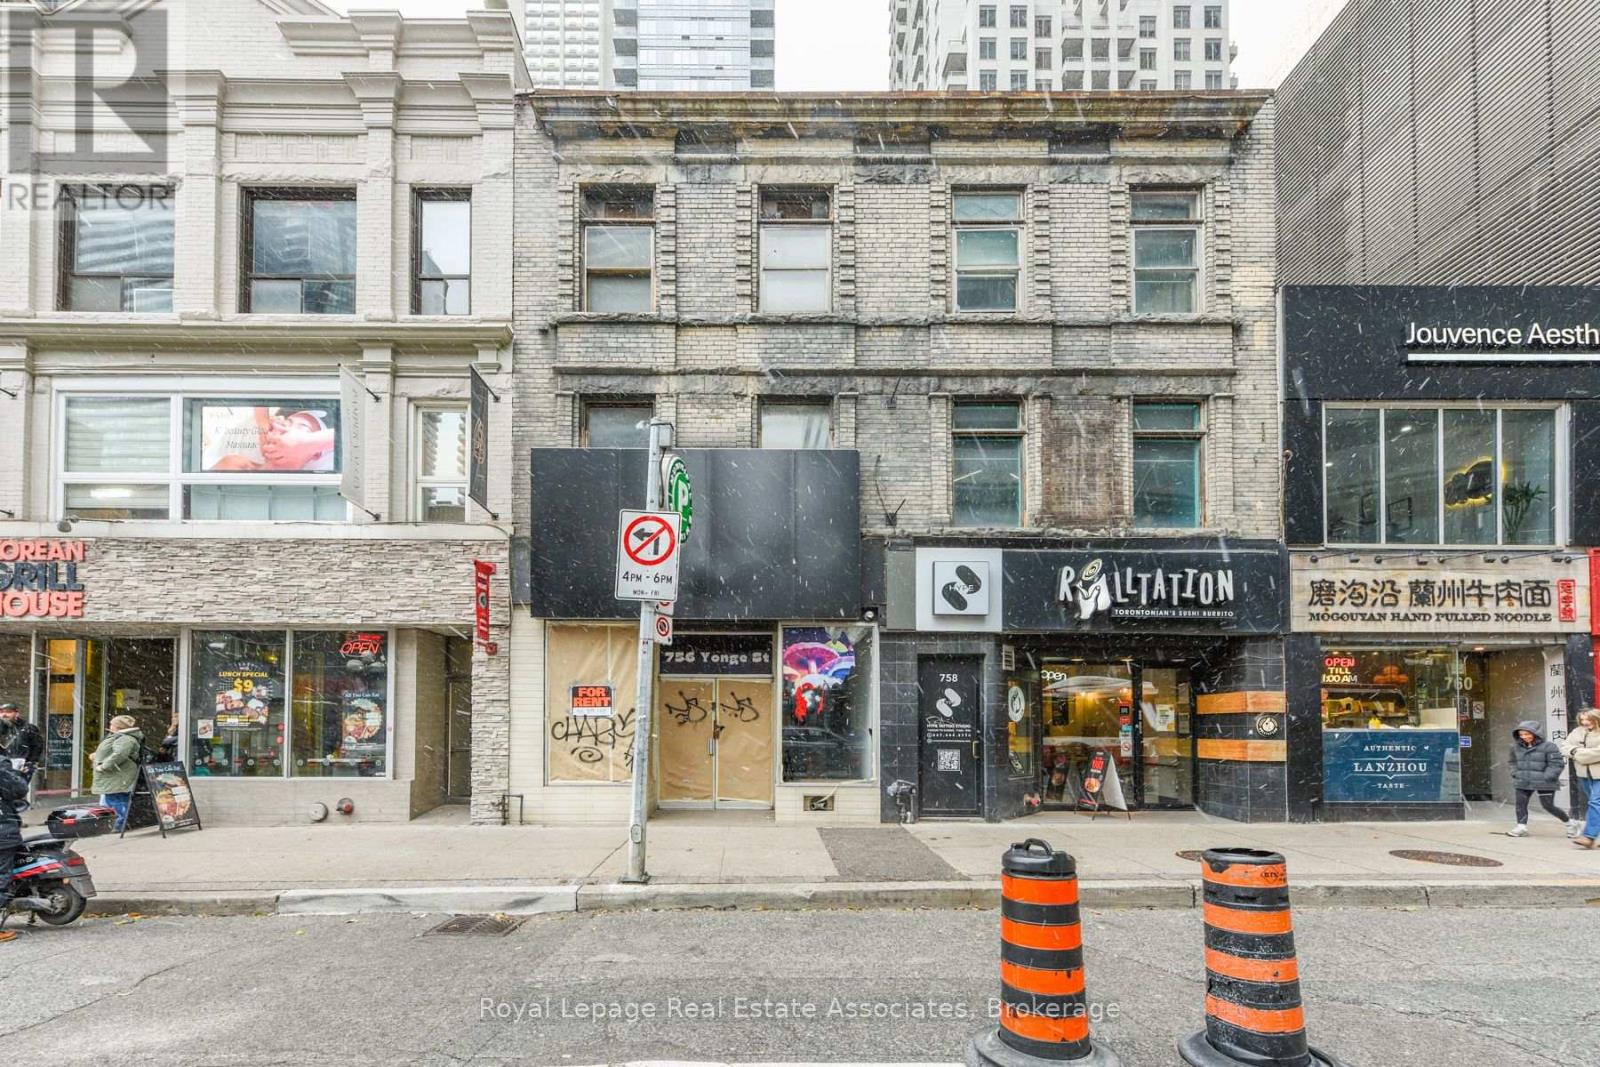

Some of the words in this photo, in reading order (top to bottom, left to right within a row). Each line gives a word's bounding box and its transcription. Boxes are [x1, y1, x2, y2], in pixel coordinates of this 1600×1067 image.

[1406, 322, 1522, 345] Jouvence
[1527, 322, 1600, 345] Aesth
[0, 538, 86, 562] OREAN
[622, 570, 642, 584] 4PM
[653, 572, 673, 584] 6PM
[948, 584, 974, 592] HYPE
[0, 591, 84, 617] OUSE
[1114, 608, 1176, 617] TORONTONIAN'S
[1202, 610, 1235, 618] BURRITO
[1308, 612, 1387, 622] MOGOUYAN
[1390, 612, 1432, 622] HAND
[1434, 612, 1491, 622] PULLED
[1494, 612, 1553, 623] NOODLE
[339, 640, 380, 655] OPEN
[664, 652, 696, 662] 756
[700, 652, 748, 665] Yonge
[751, 652, 770, 663] St
[1325, 657, 1356, 667] OPEN
[1327, 667, 1352, 675] TILL
[939, 673, 959, 683] 758
[1341, 675, 1358, 683] AM
[1443, 676, 1473, 691] 760
[233, 678, 254, 693] $9
[577, 687, 607, 697] FOR
[573, 697, 612, 706] RENT
[1549, 664, 1567, 764] 蘭州牛肉
[1353, 762, 1428, 773] LANZHOU
